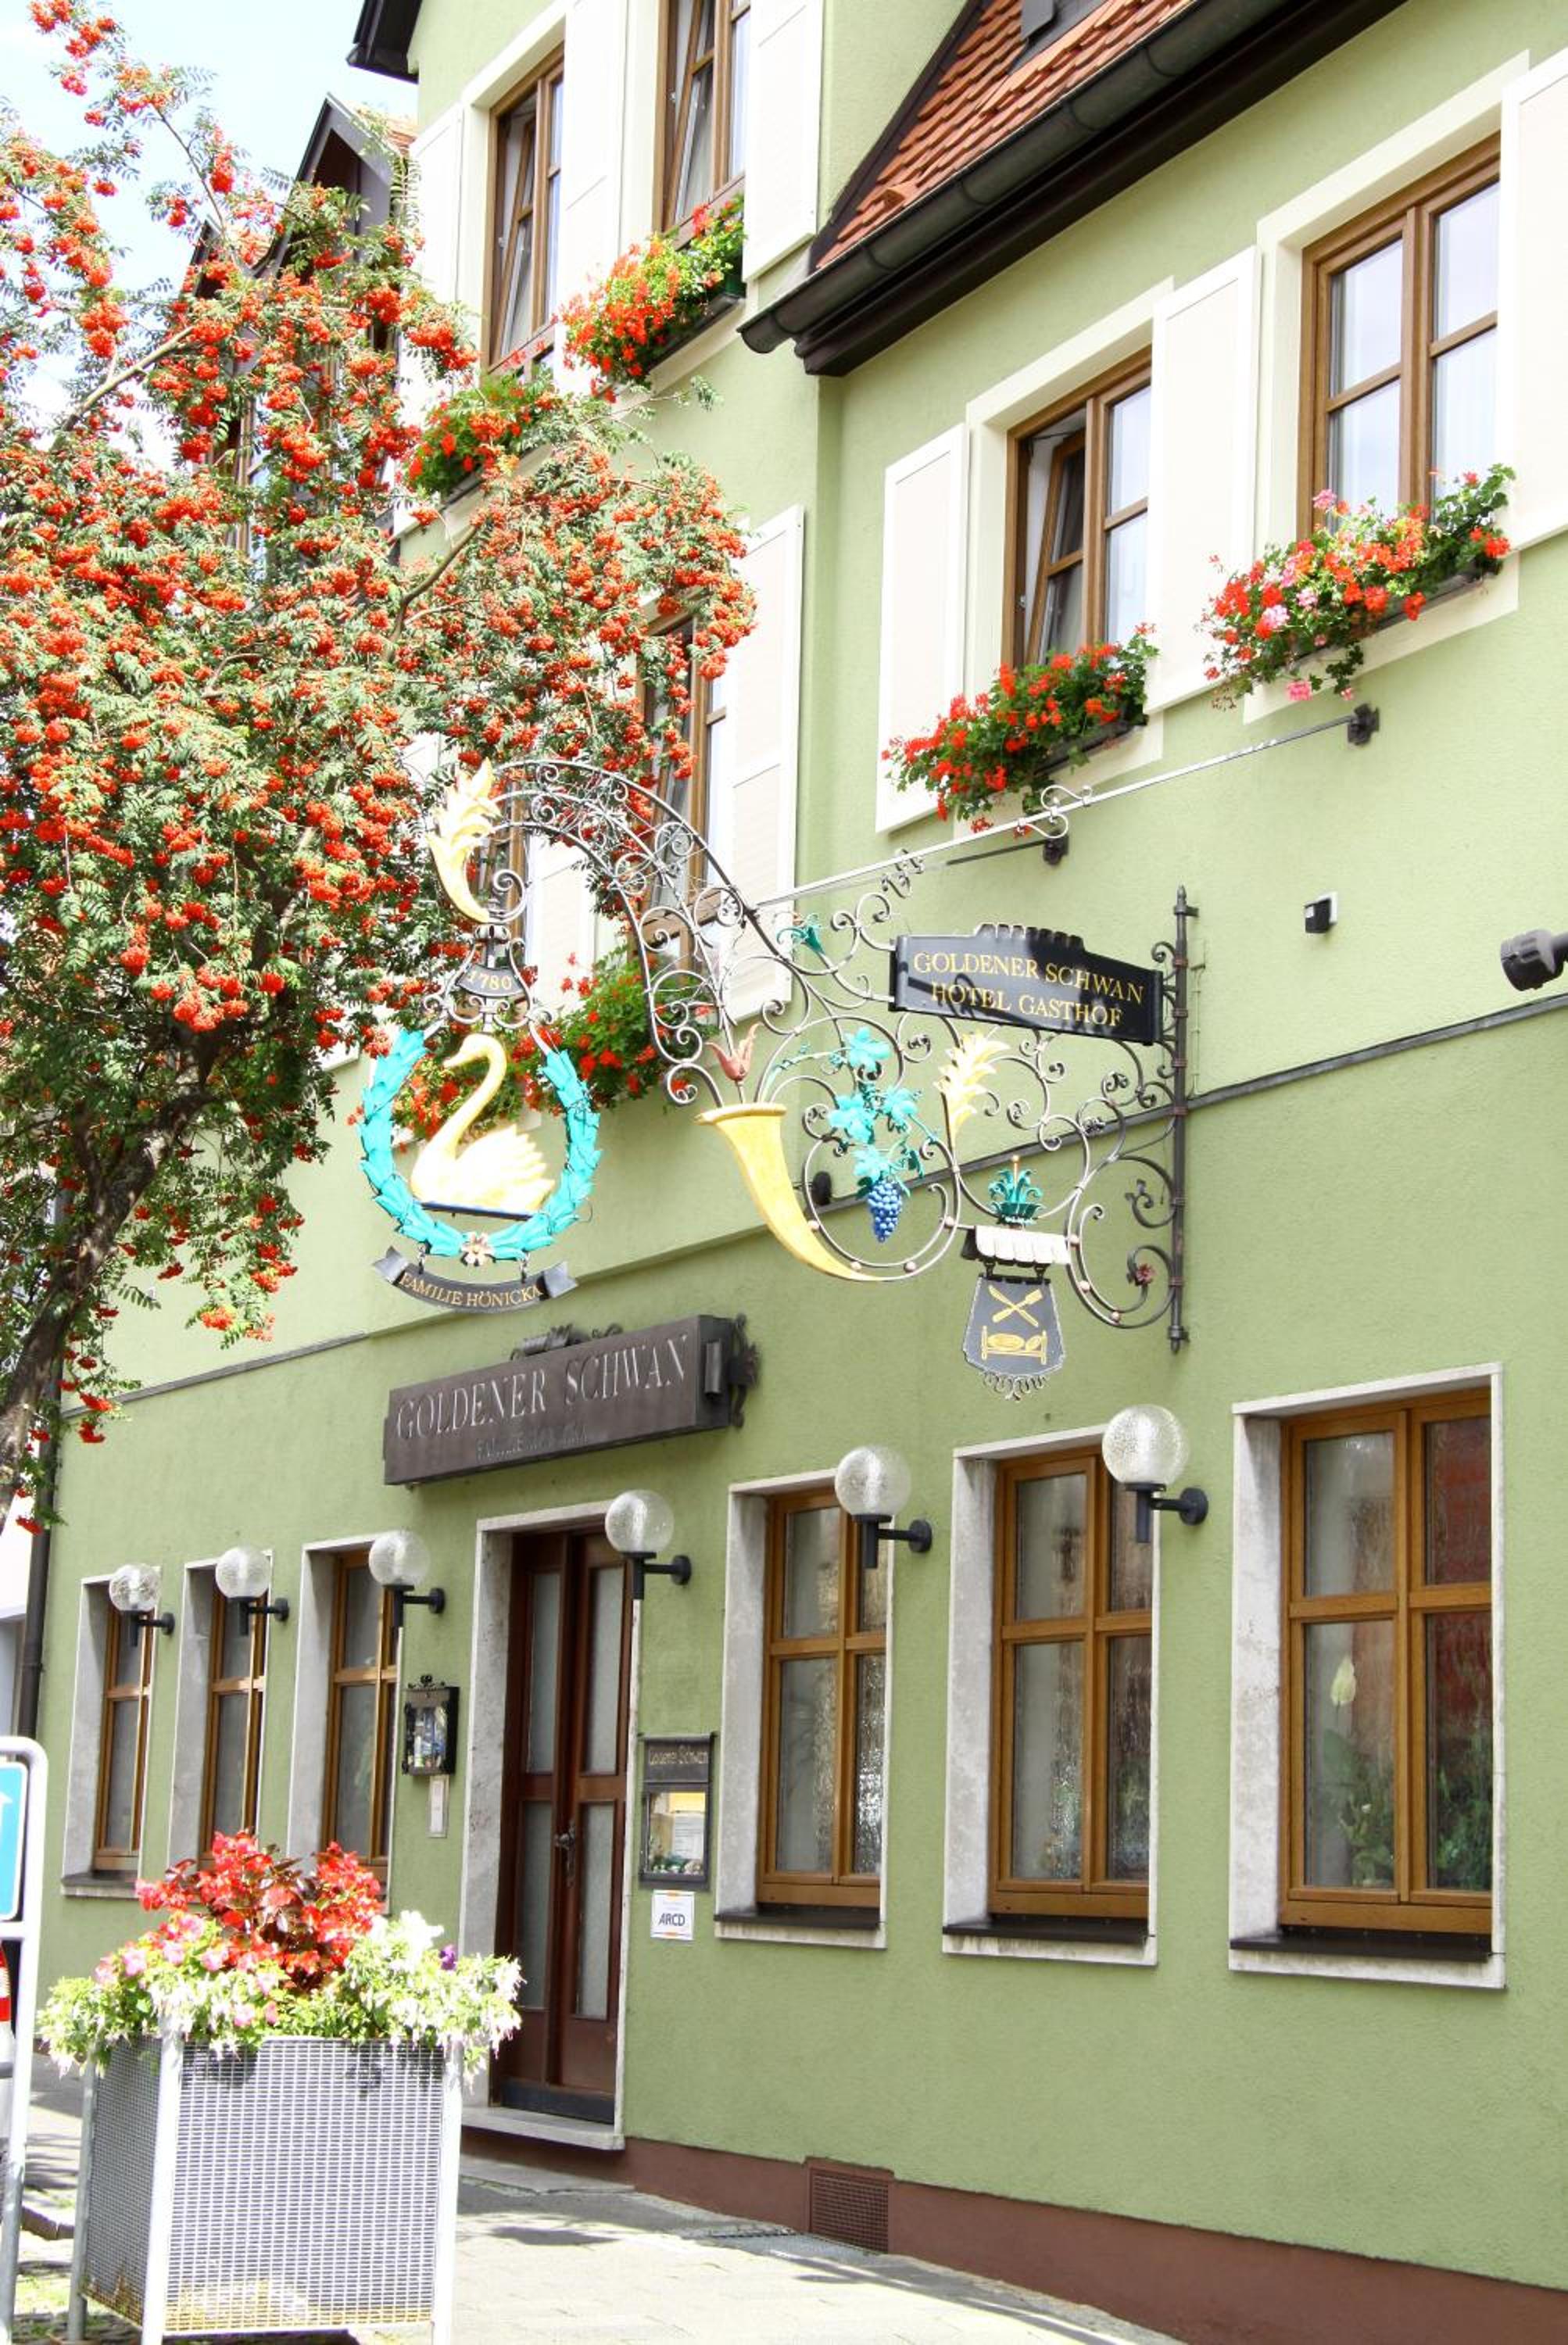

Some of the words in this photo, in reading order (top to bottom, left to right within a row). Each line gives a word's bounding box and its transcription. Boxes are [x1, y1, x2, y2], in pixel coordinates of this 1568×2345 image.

[913, 952, 1039, 979] GOLDENER
[1045, 962, 1144, 1004] SCHWAN
[932, 982, 1011, 1011] HOTEL
[1019, 994, 1124, 1026] GASTHOF
[399, 1272, 463, 1305] FAMILIE
[466, 1285, 543, 1307] HÖNICKA
[396, 1368, 546, 1439] GOLDENER
[564, 1334, 689, 1406] SCHWAN
[658, 1913, 686, 1927] ARCD
